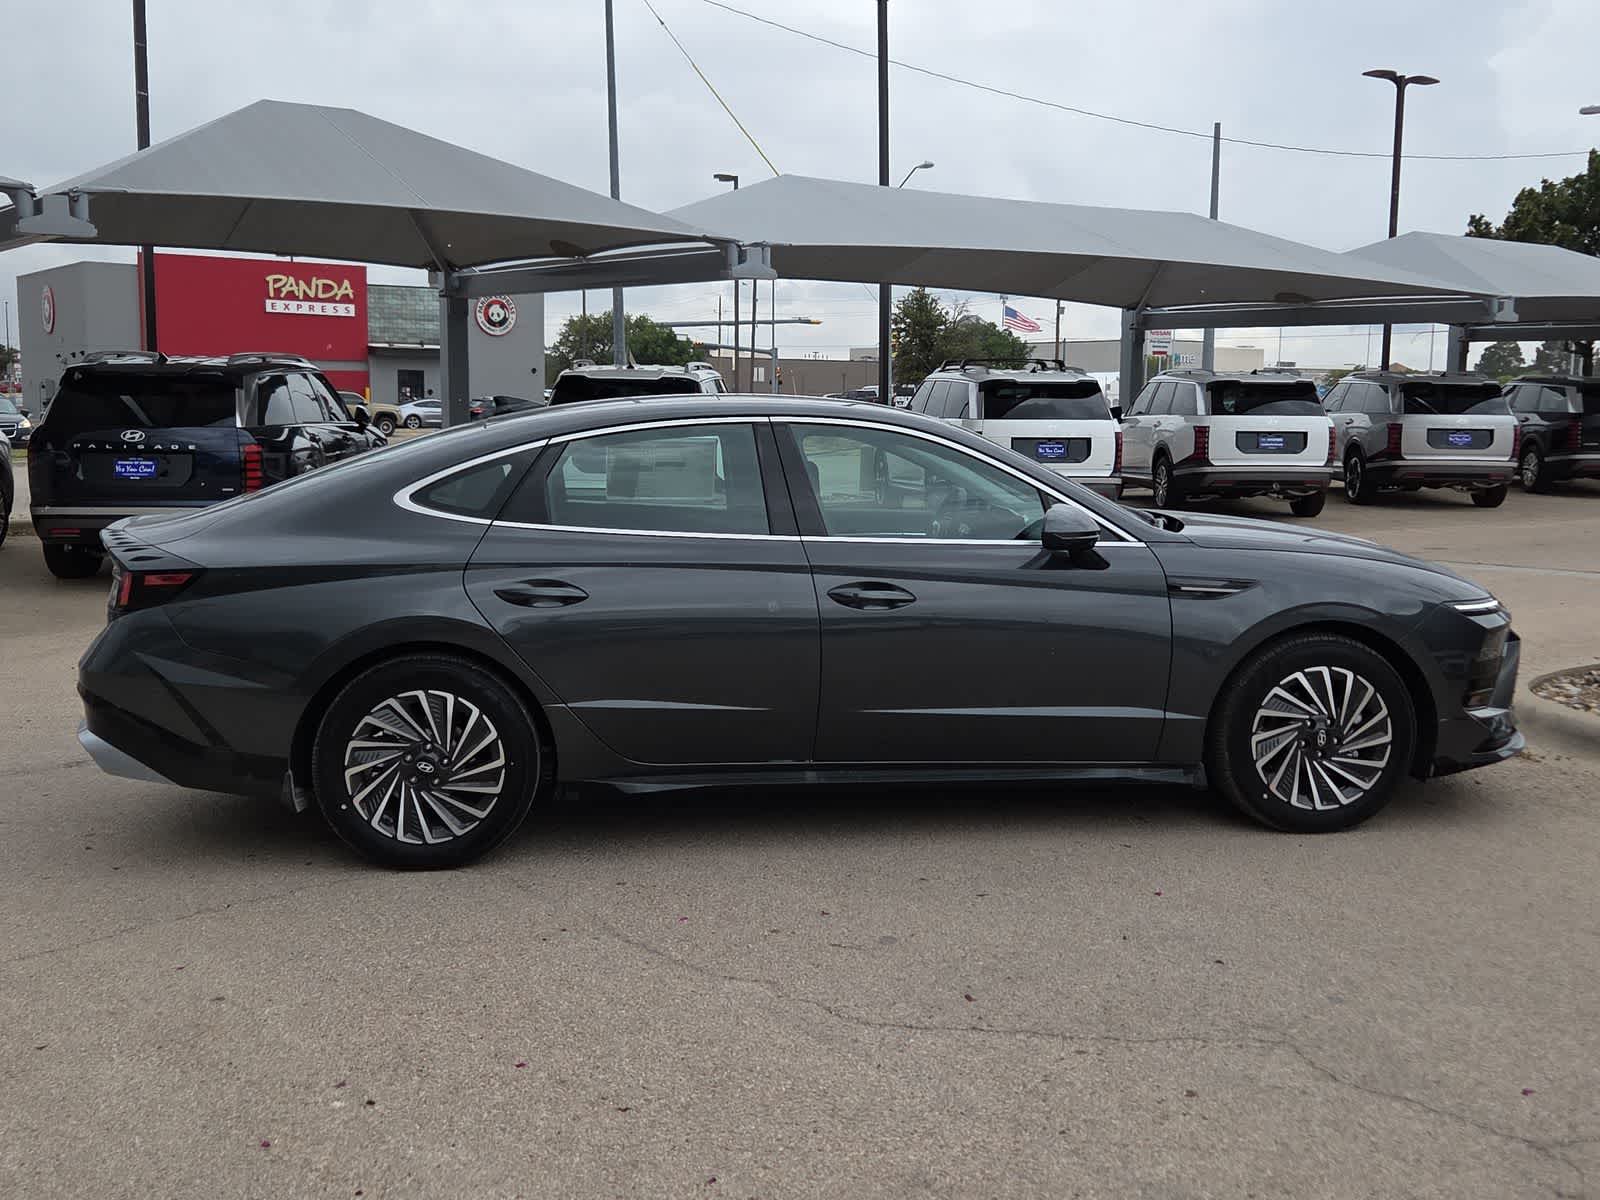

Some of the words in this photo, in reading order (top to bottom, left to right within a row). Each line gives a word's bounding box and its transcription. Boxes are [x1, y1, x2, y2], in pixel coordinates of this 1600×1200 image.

[265, 274, 354, 301] PANDA
[271, 302, 351, 314] EXPRESS
[115, 464, 125, 473] Yes
[126, 464, 138, 473] You
